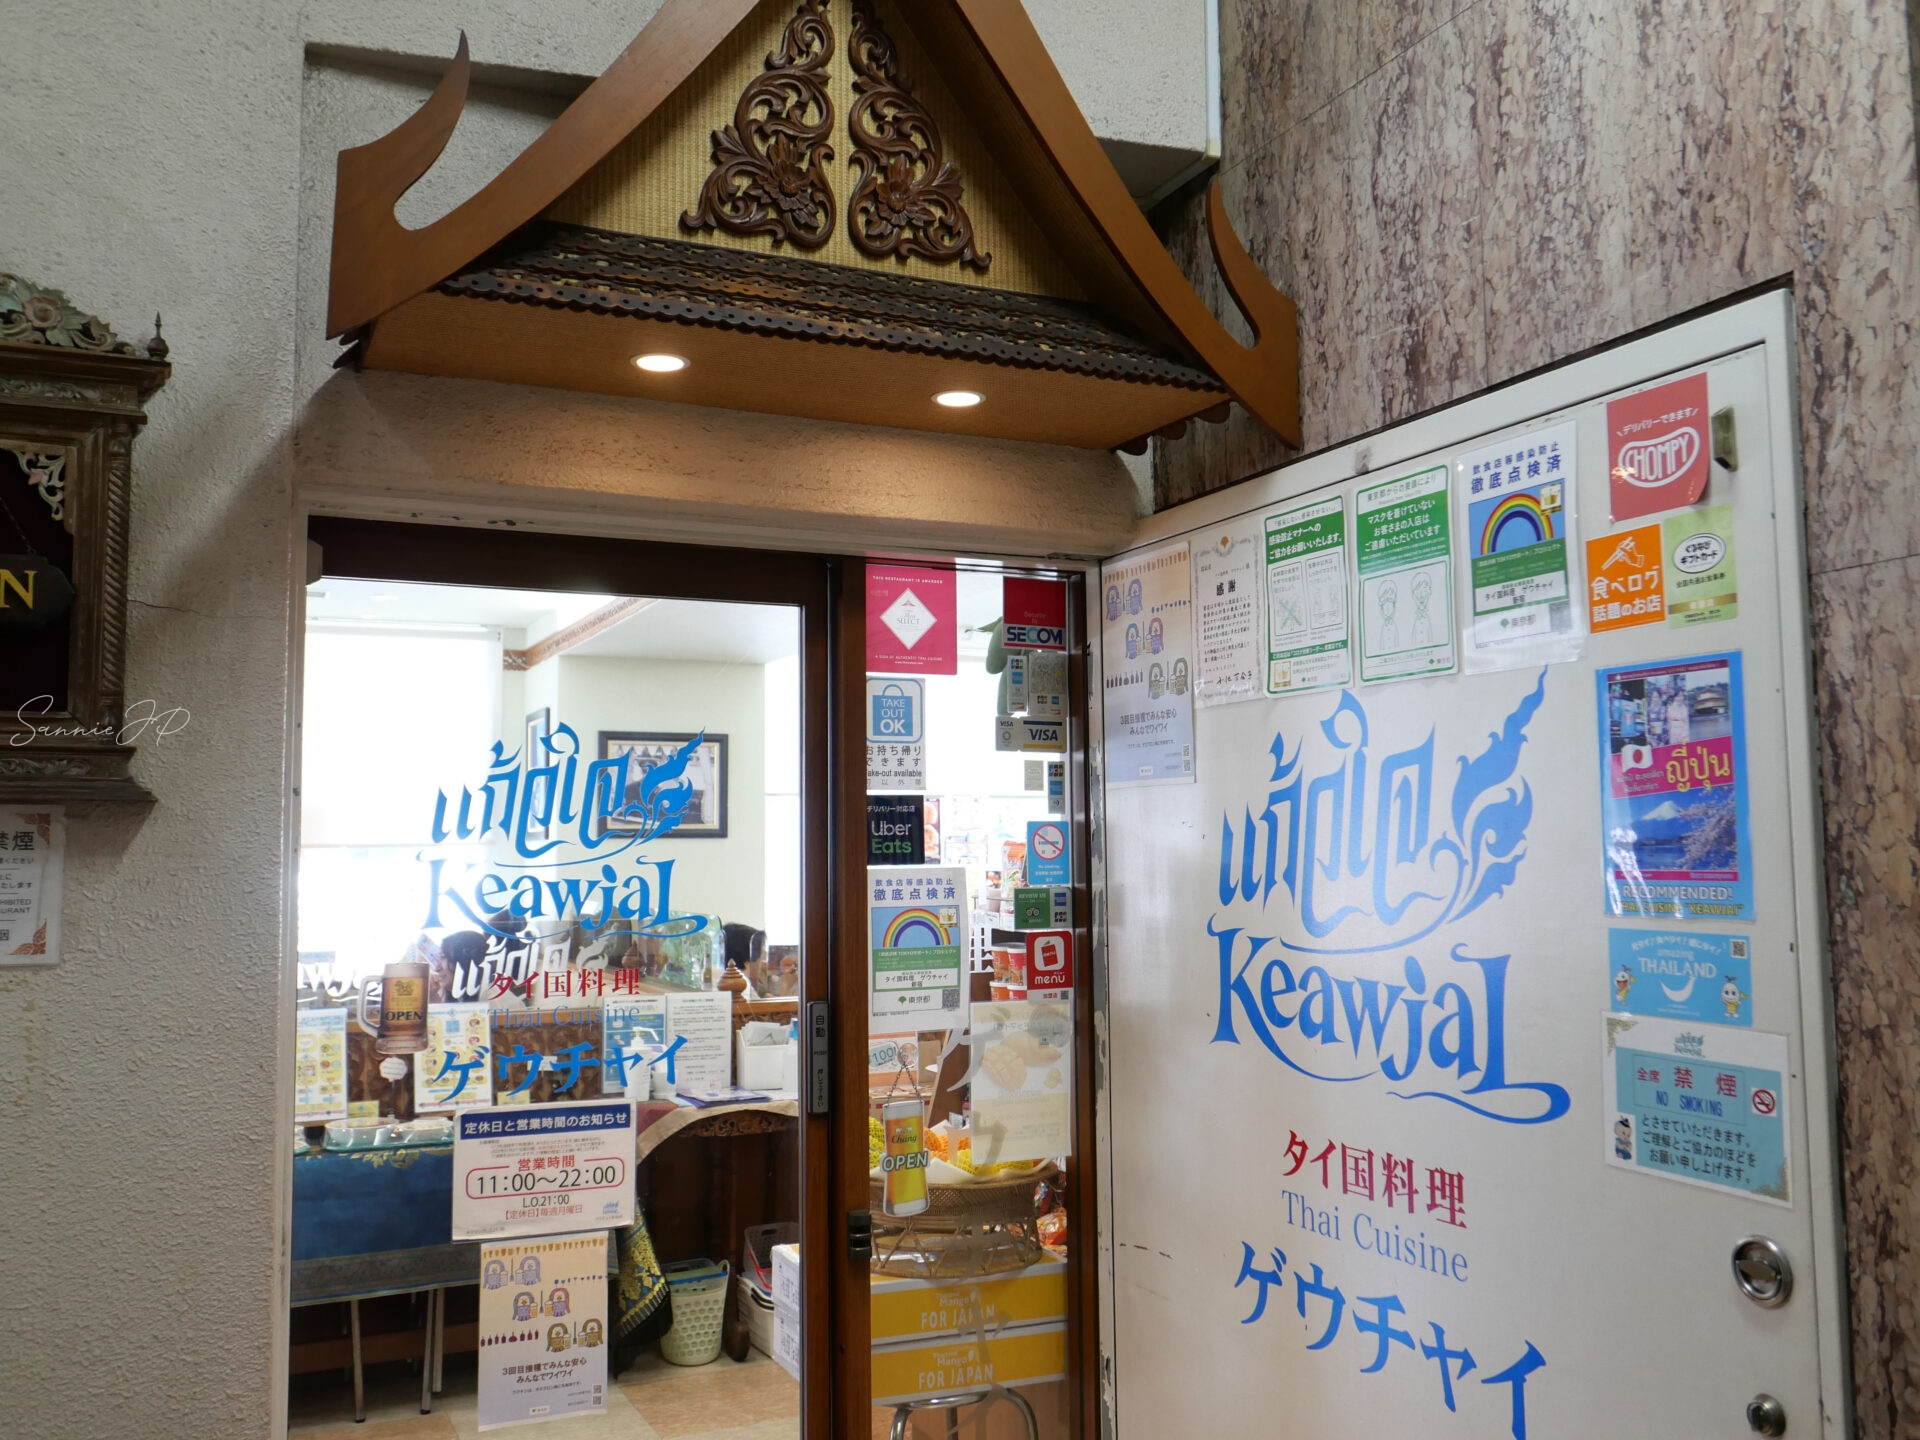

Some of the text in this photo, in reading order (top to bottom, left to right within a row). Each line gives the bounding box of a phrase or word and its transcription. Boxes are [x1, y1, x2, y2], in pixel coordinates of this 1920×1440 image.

[1625, 434, 1690, 481] CHOMPY
[1471, 454, 1562, 494] 徹底点検済
[1373, 513, 1430, 537] お客さまの入店は
[1591, 564, 1659, 601] 食べログ
[1592, 594, 1661, 623] 話題のお店
[1006, 626, 1063, 645] SECOM
[881, 698, 905, 707] TAKE
[881, 708, 905, 718] OUT
[880, 719, 906, 734] OK
[1028, 728, 1058, 741] VISA
[866, 769, 922, 777] ake-out available
[1665, 741, 1731, 793] ญี่ปุ่น
[871, 820, 912, 836] Uber
[871, 839, 912, 854] Eats
[875, 878, 954, 887] 飲食店等感染防止
[1622, 885, 1734, 901] RECOMMENDED!
[873, 887, 956, 901] 徹底点検済
[1638, 956, 1717, 979] THAILAND
[487, 967, 640, 1000] タイ国料理
[1035, 974, 1066, 985] menu
[384, 1011, 424, 1021] OPEN
[487, 1004, 640, 1029] Thai Cuisine
[431, 1034, 689, 1103] ゲウチャイ
[1637, 1067, 1660, 1083] 全席
[1656, 1090, 1723, 1118] NO SMOKING
[464, 1112, 628, 1135] 定休日と営業時間のお知らせ
[1642, 1114, 1750, 1148] とさせていただきます。
[1642, 1130, 1757, 1168] ご理解とご協力のほどを
[517, 1154, 576, 1173] 営業時間
[881, 1152, 929, 1172] OPEN
[1649, 1148, 1751, 1184] お願い申し上げます。
[1282, 1129, 1468, 1230] タイ国料理
[505, 1204, 583, 1220] 【定休日】毎週月曜日
[1282, 1189, 1469, 1282] Thai Cuisine
[921, 1311, 948, 1330] FOR
[1234, 1240, 1547, 1440] ゲウチャイ
[516, 1369, 574, 1384] みんなでワイワイ
[918, 1363, 994, 1390] FOR JAPAN
